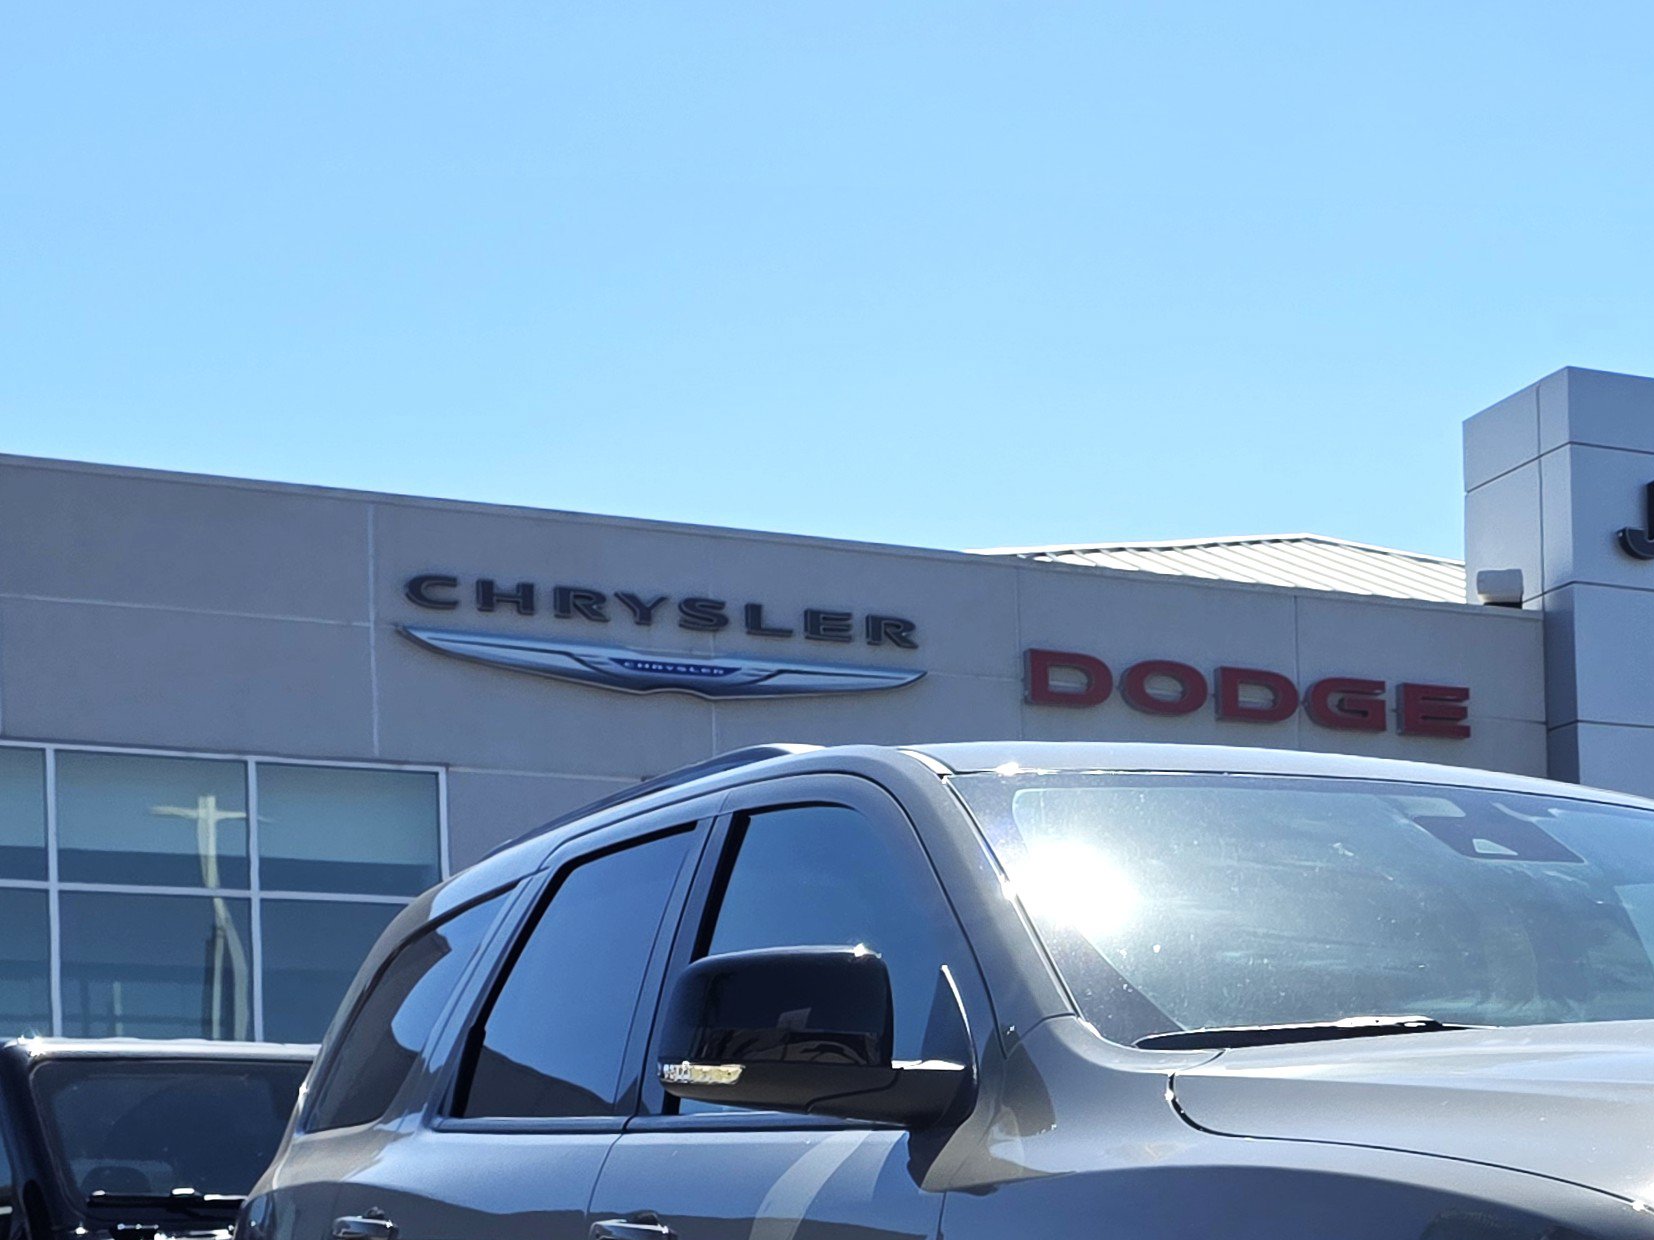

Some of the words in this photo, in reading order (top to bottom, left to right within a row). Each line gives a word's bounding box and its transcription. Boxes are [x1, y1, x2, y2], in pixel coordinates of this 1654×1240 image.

[405, 583, 919, 649] CHRYSLER
[624, 660, 724, 676] CHRYSLER
[1024, 648, 1471, 739] DODGE
